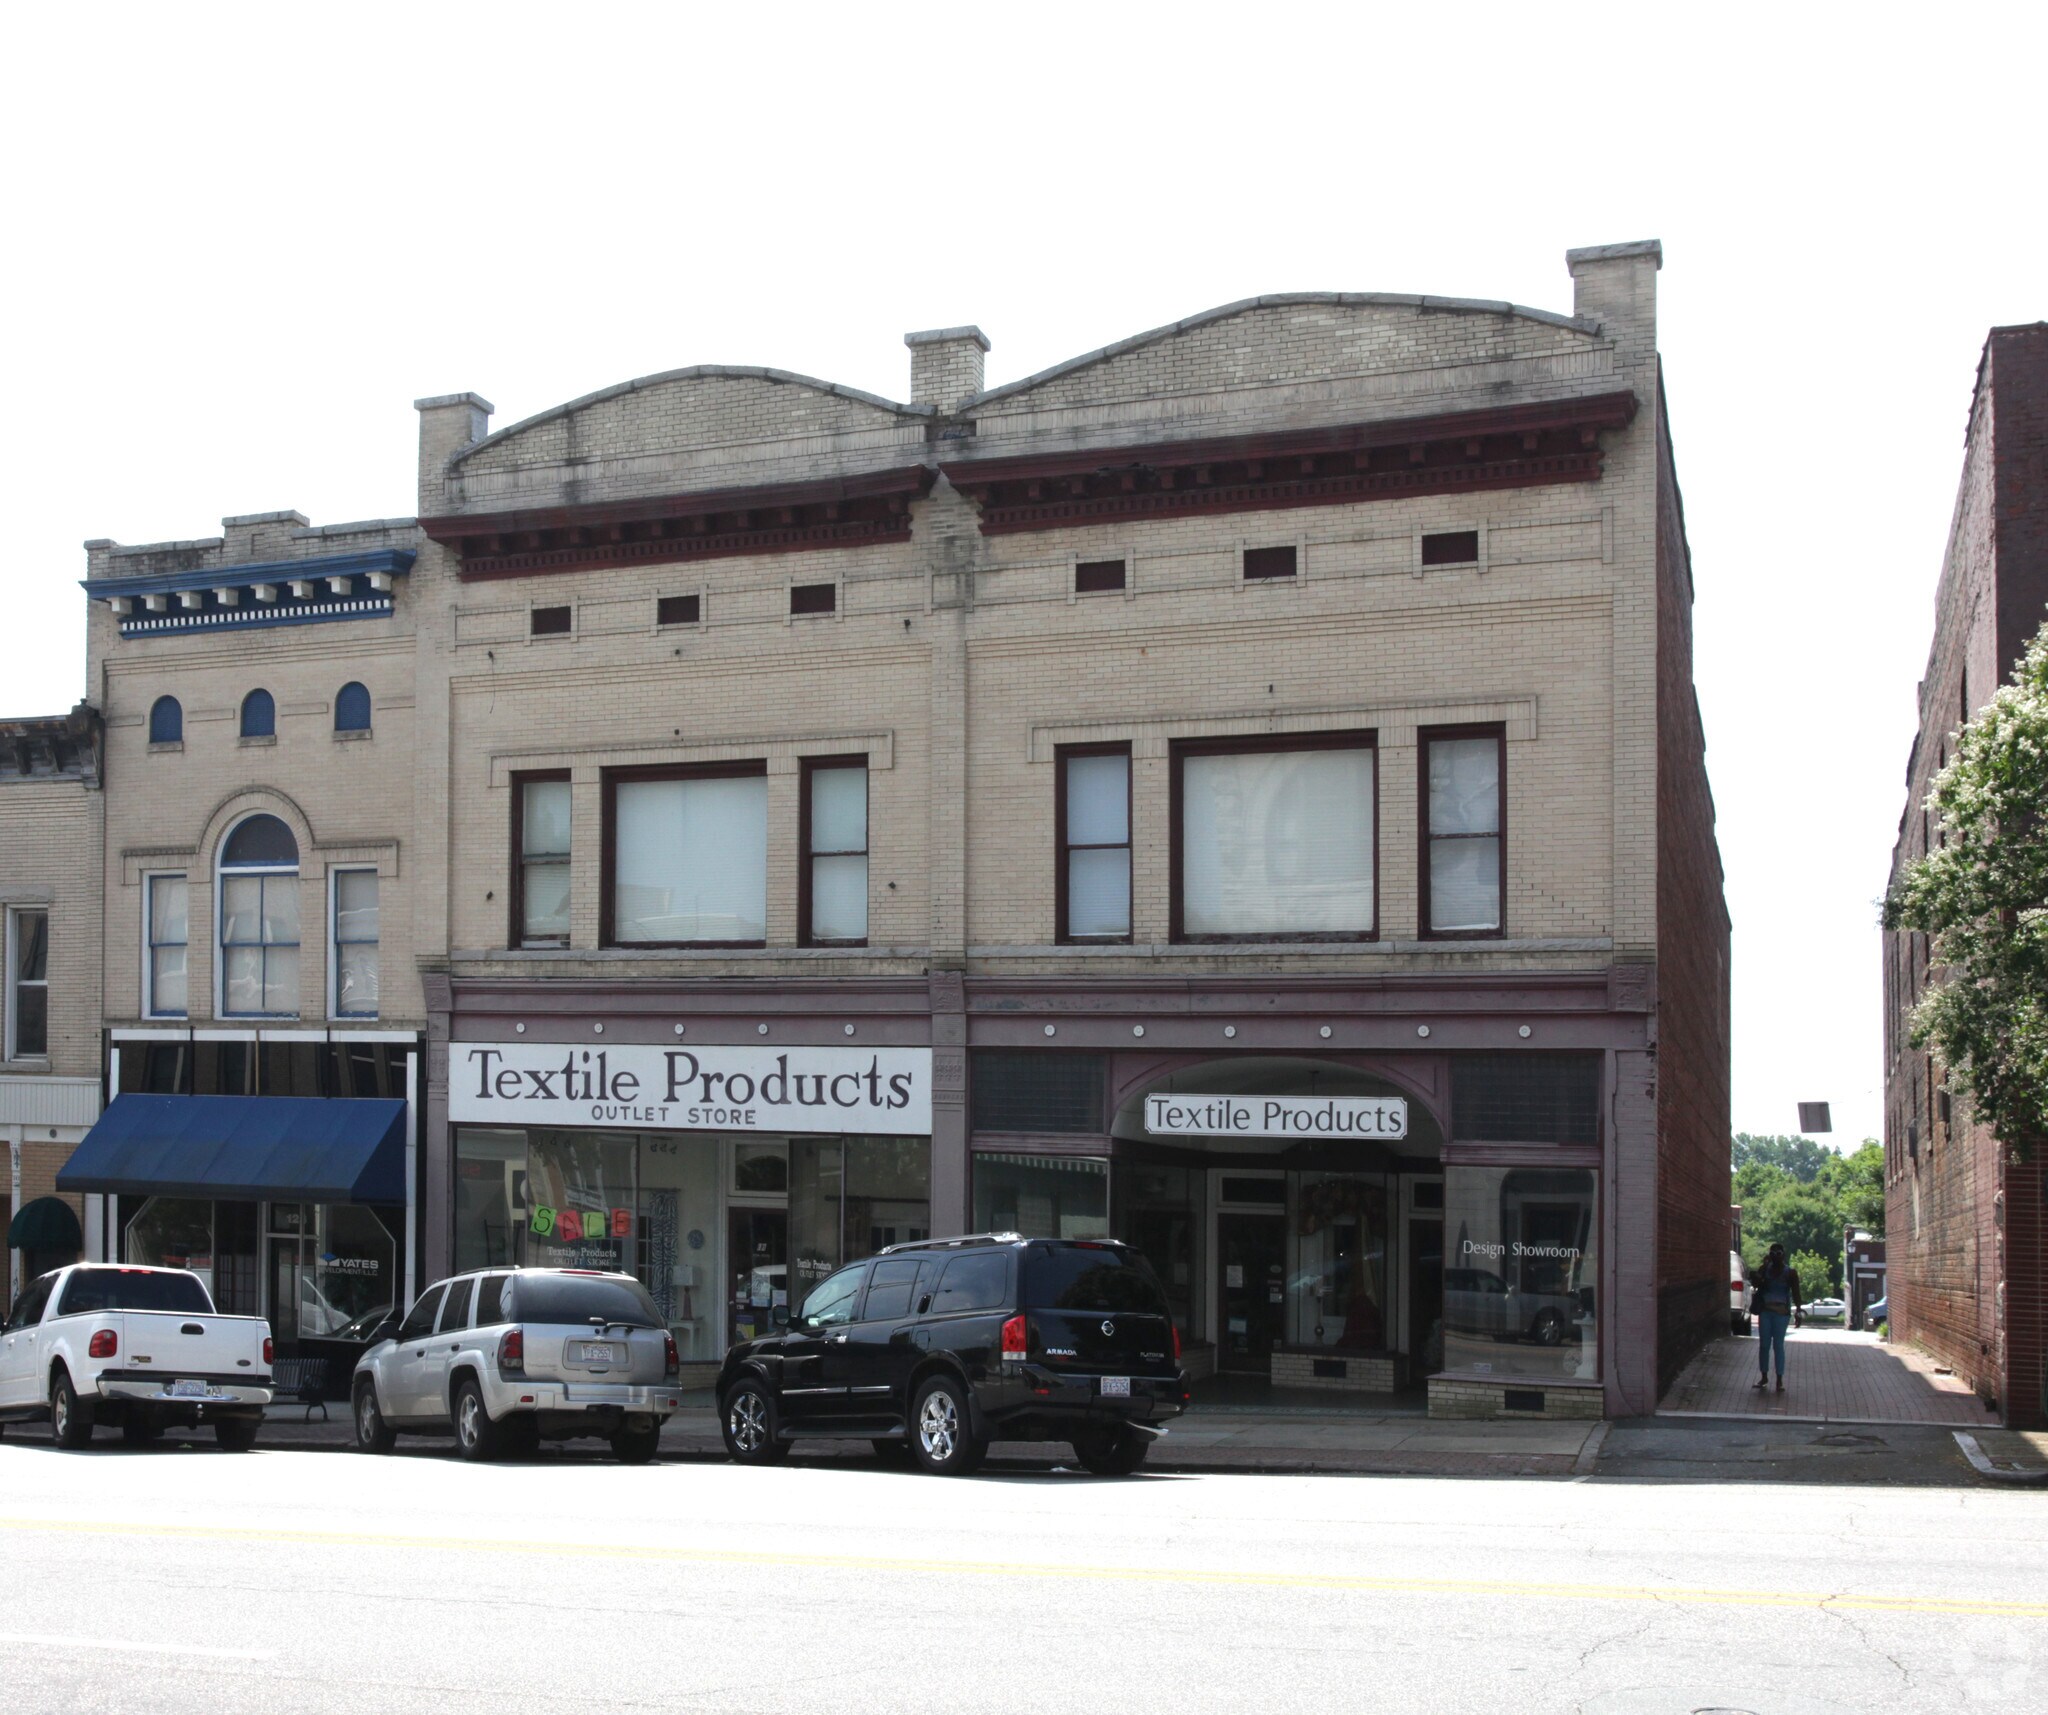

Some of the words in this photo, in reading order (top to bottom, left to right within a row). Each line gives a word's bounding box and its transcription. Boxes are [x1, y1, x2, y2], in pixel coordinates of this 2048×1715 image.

[468, 1049, 640, 1102] Textile
[662, 1051, 912, 1110] Products
[591, 1104, 670, 1122] OUTLET
[687, 1107, 757, 1125] STORE
[1150, 1099, 1251, 1130] Textile
[1263, 1100, 1402, 1133] Products
[533, 1207, 630, 1240] SALE
[547, 1246, 577, 1257] Textile
[580, 1247, 617, 1258] Products
[1462, 1240, 1505, 1260] Design
[1511, 1241, 1580, 1258] Showroom
[340, 1258, 379, 1270] YATES
[553, 1257, 583, 1266] OUTLET
[587, 1258, 610, 1267] STORE
[1046, 1348, 1077, 1356] ARMADA
